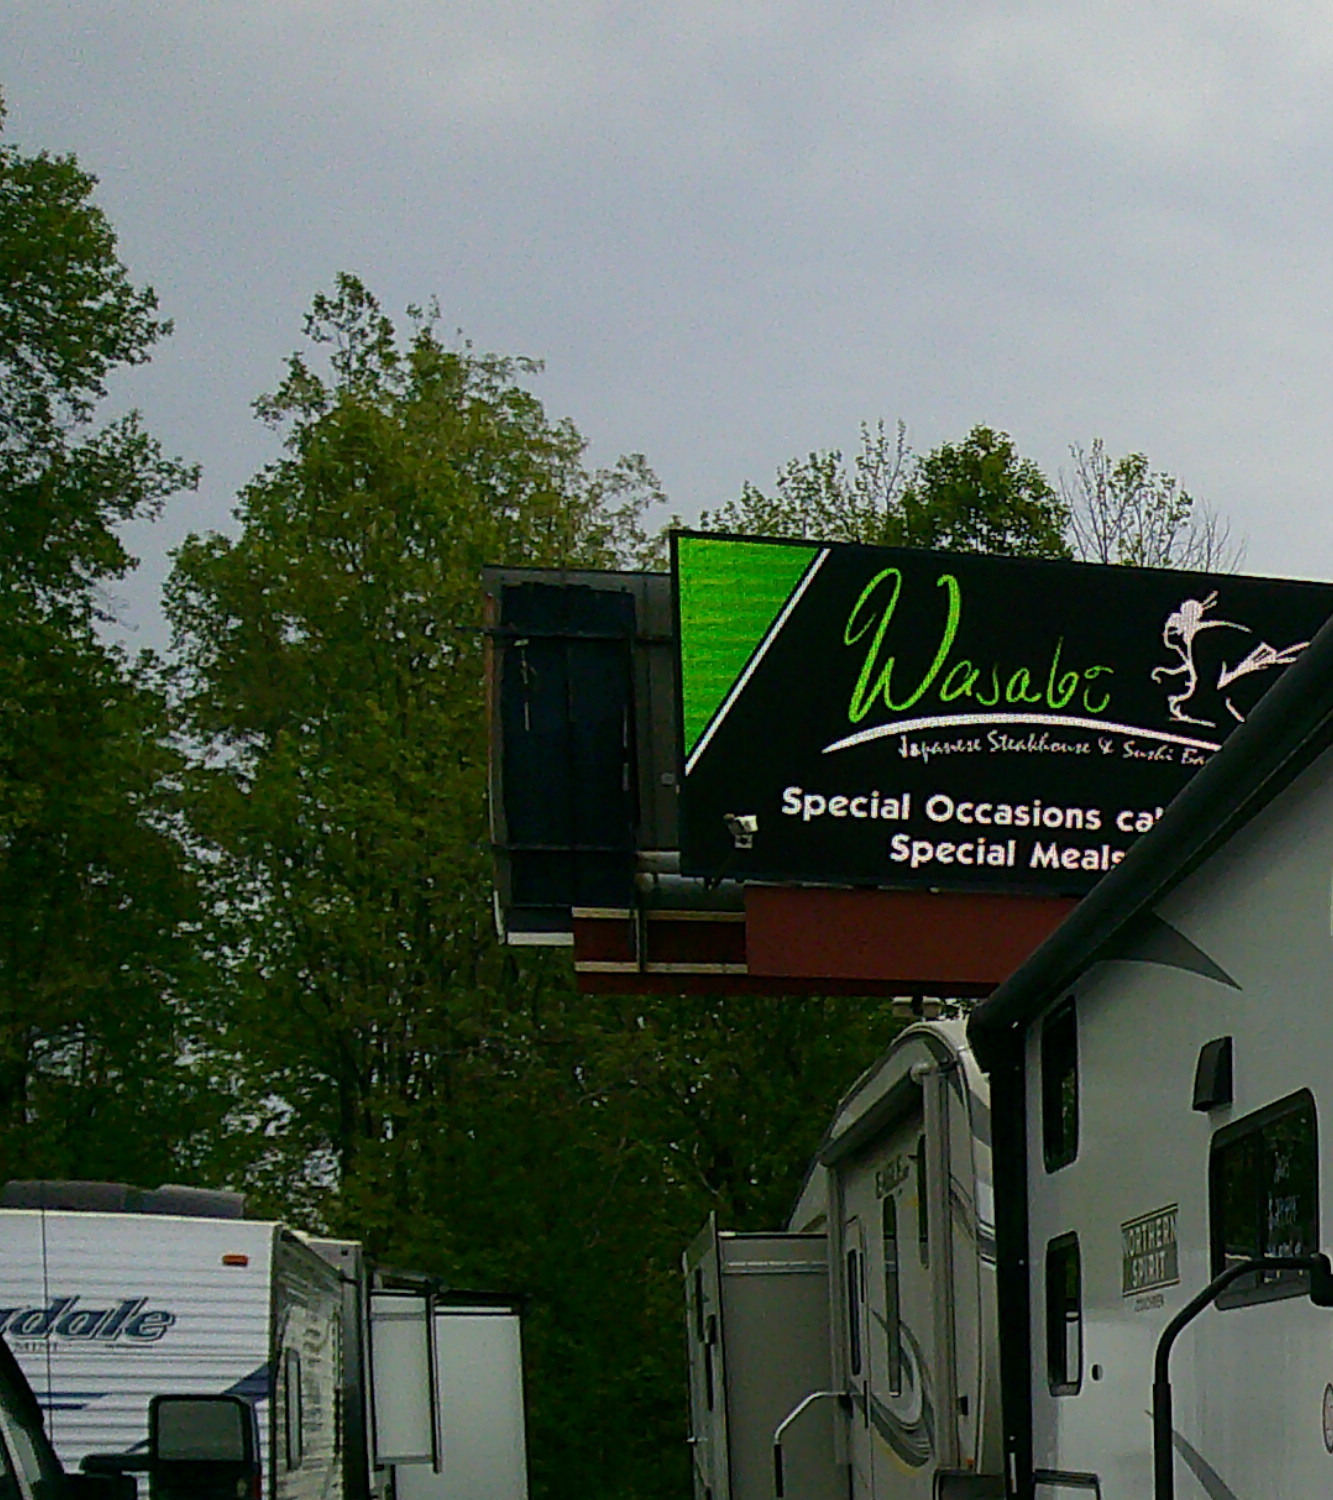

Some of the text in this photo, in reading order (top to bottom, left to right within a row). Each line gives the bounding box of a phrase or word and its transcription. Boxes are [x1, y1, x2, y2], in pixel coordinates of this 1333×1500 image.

[844, 567, 1115, 722] Wasabi
[898, 735, 982, 764] Japanese
[987, 730, 1092, 755] Steakhouse
[1098, 737, 1115, 754] &
[1123, 741, 1174, 762] Sushi
[781, 786, 912, 822] Special
[925, 793, 1102, 832] Occasions
[890, 832, 1016, 869] Special
[1121, 1215, 1177, 1258] NORTHERN
[1132, 1250, 1166, 1288] SPIRIT
